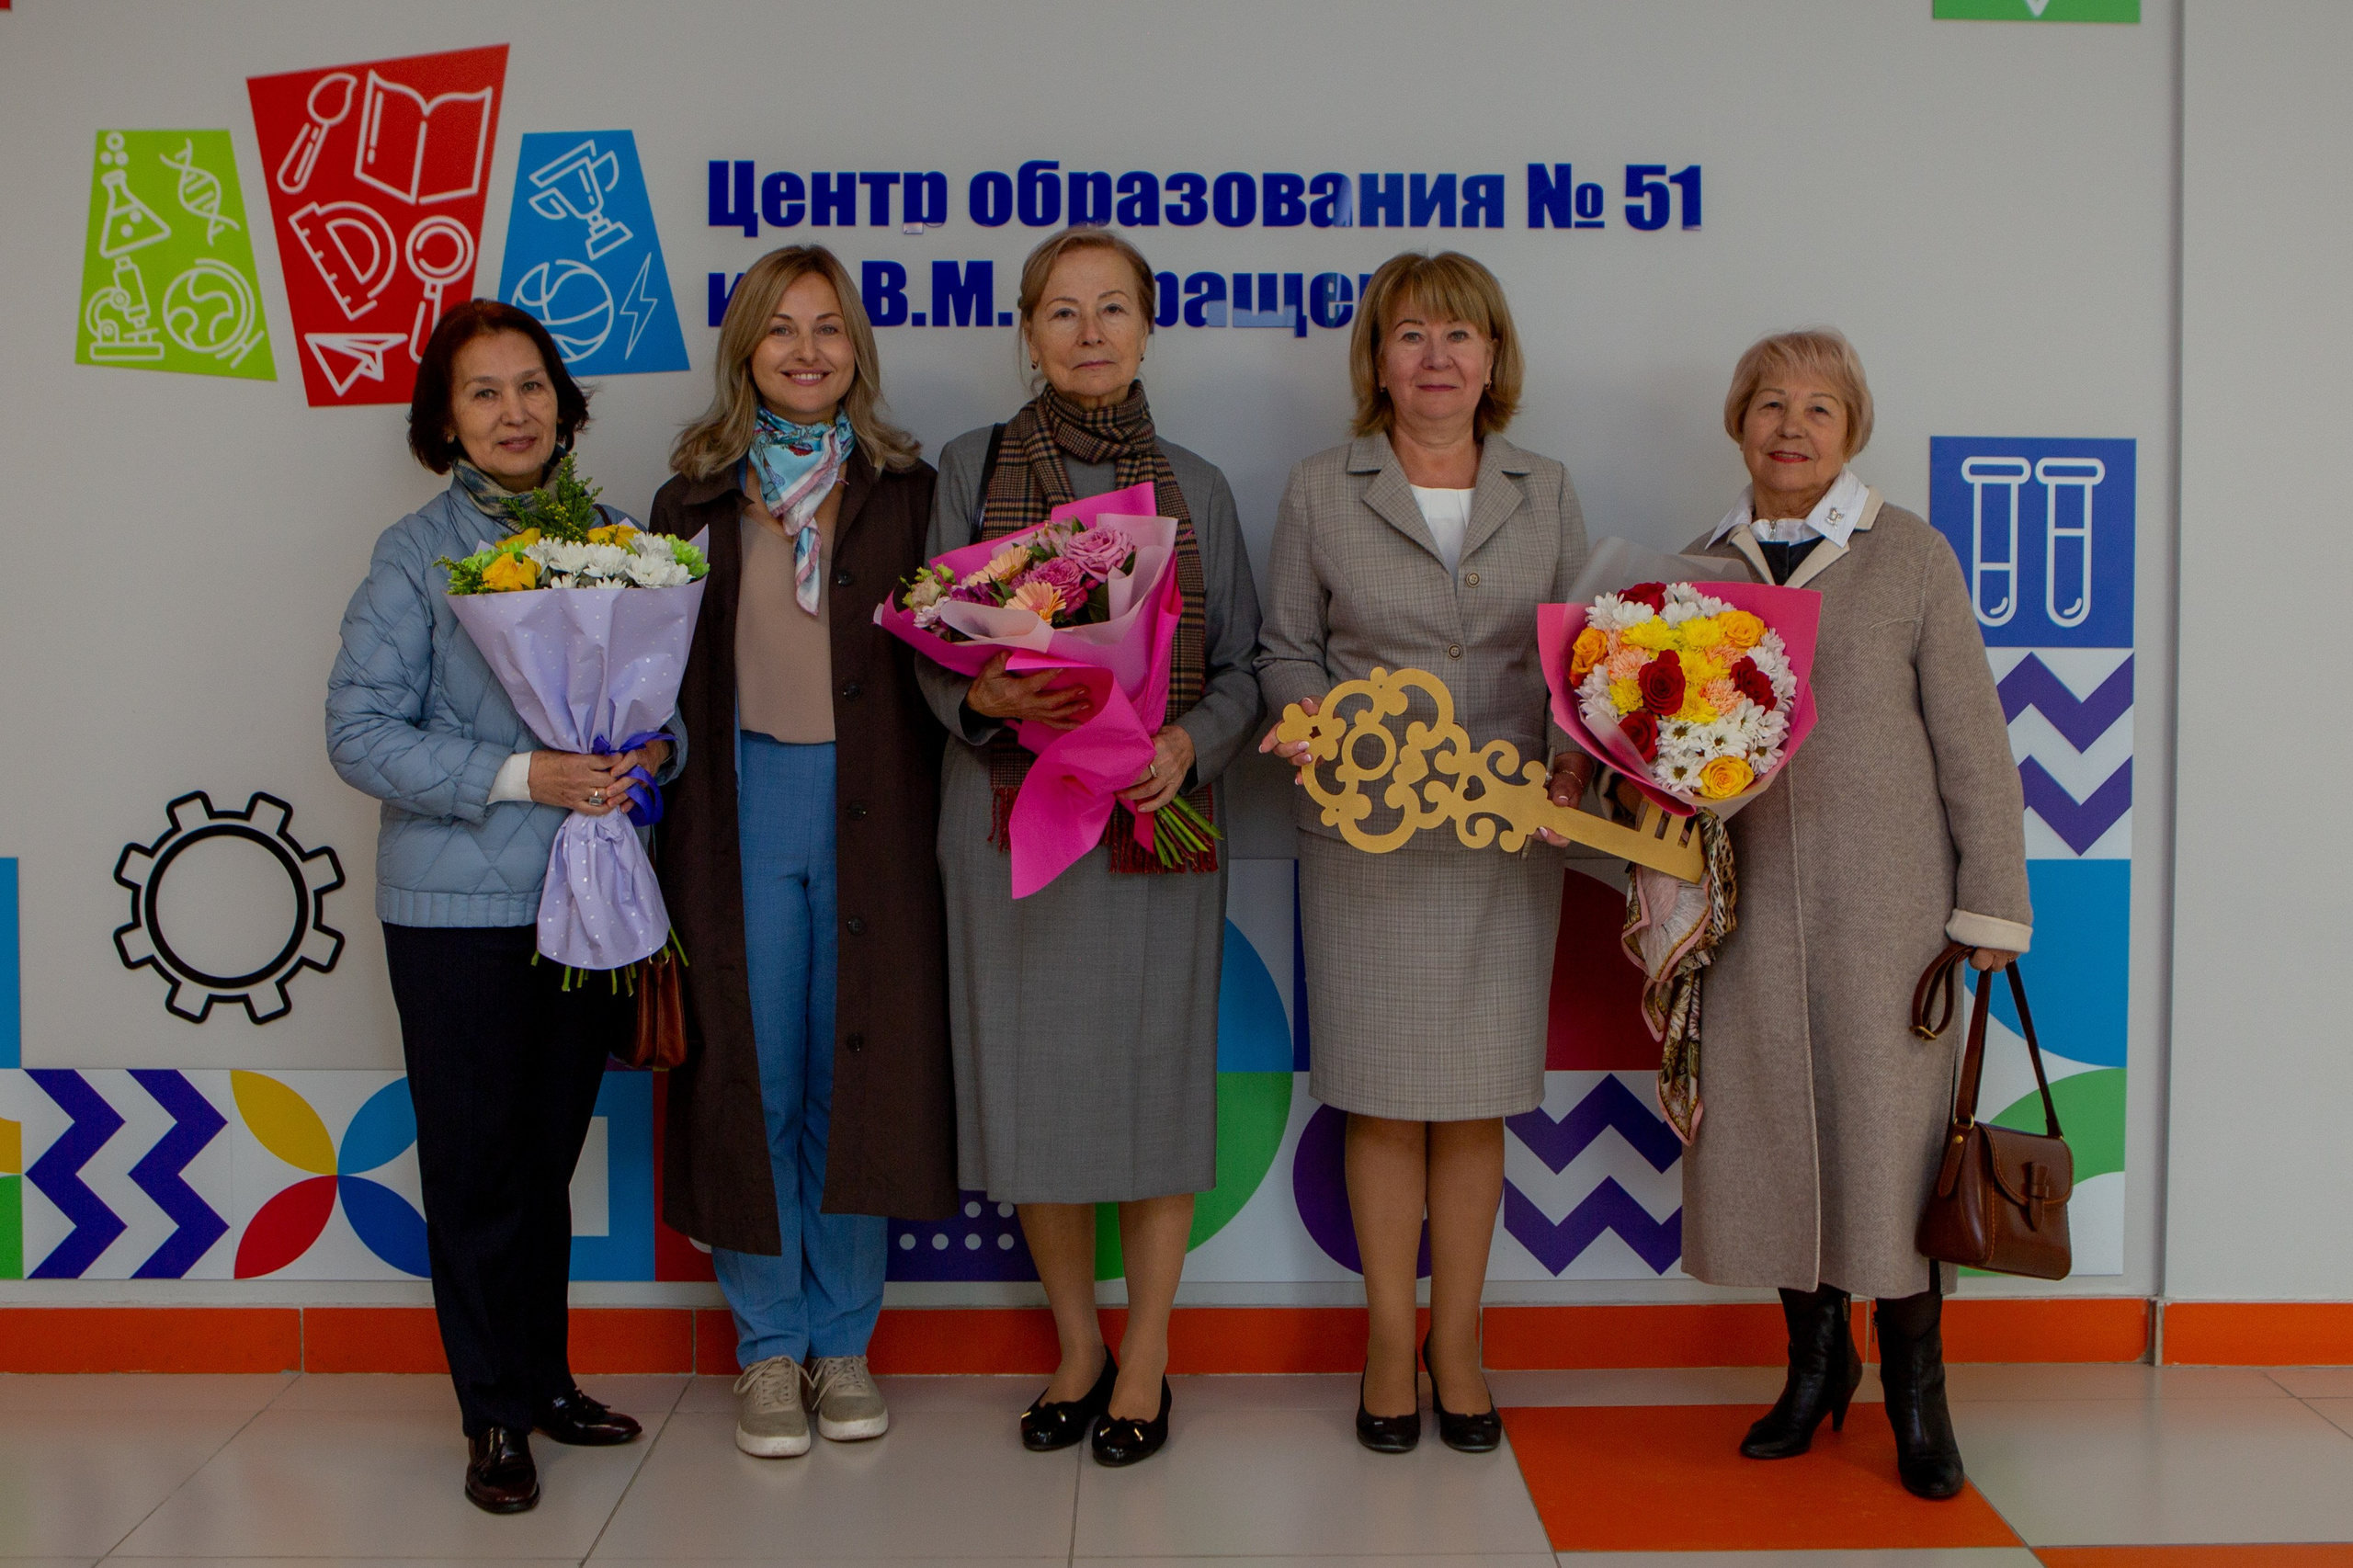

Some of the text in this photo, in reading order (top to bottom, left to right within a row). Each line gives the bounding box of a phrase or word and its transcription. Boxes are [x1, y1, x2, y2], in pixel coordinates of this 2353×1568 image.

[707, 159, 1703, 237] Центр образования № 51
[860, 259, 1014, 327] В.М.
